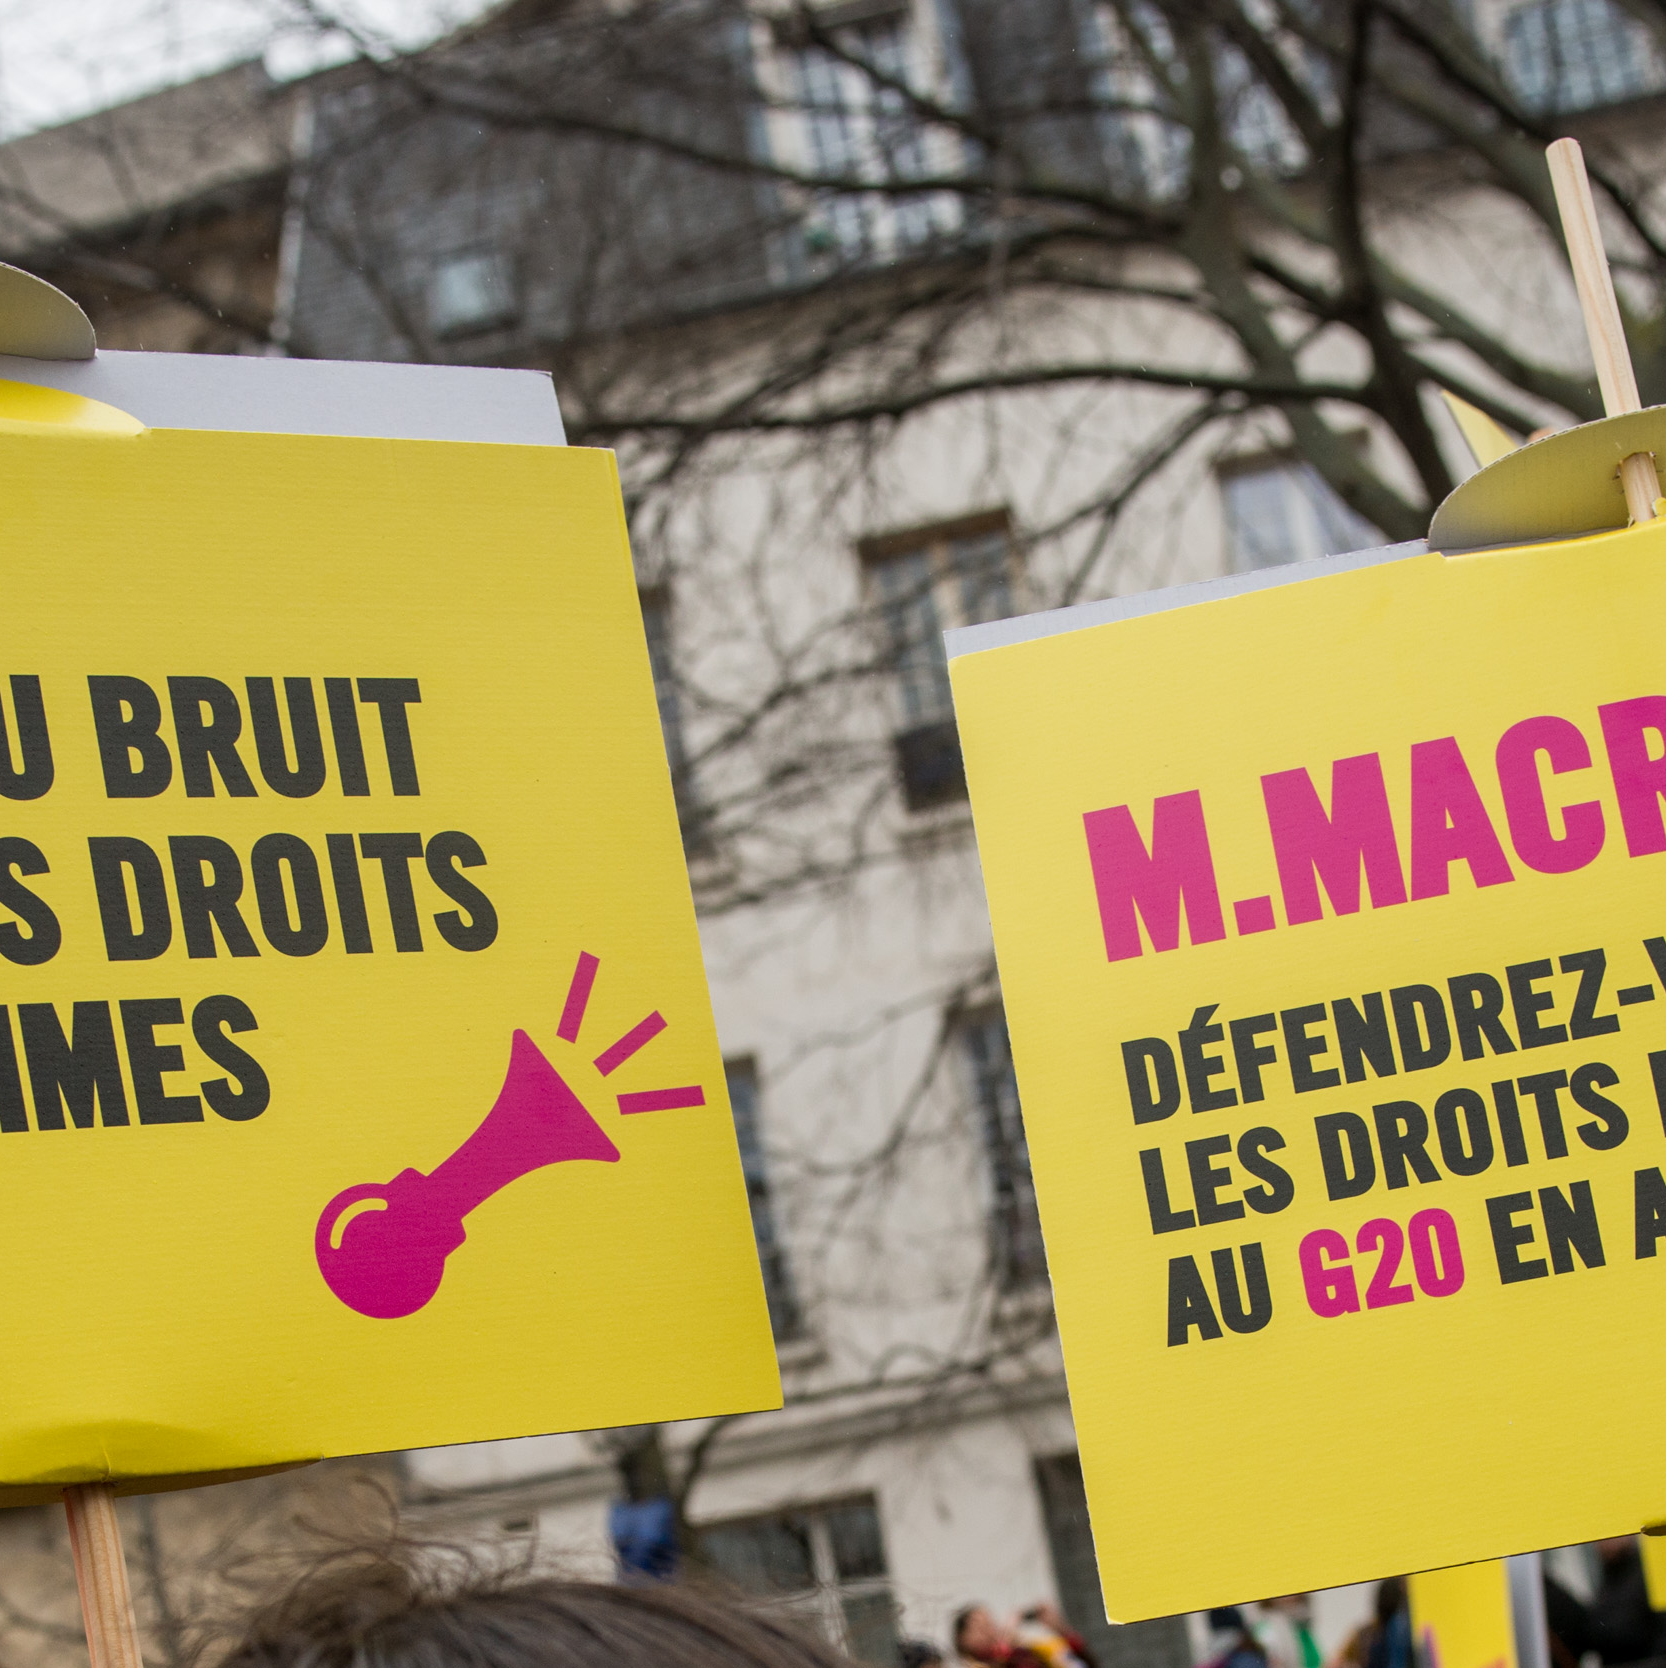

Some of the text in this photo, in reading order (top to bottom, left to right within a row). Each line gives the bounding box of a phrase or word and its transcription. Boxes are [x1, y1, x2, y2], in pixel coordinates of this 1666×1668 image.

[86, 674, 422, 799] BRUIT
[87, 830, 499, 962] DROITS
[1139, 1126, 1295, 1235] LES
[1314, 1062, 1630, 1202] DROITS
[1167, 1241, 1273, 1348] AU
[1297, 1207, 1466, 1319] G20
[1484, 1179, 1606, 1285] EN
